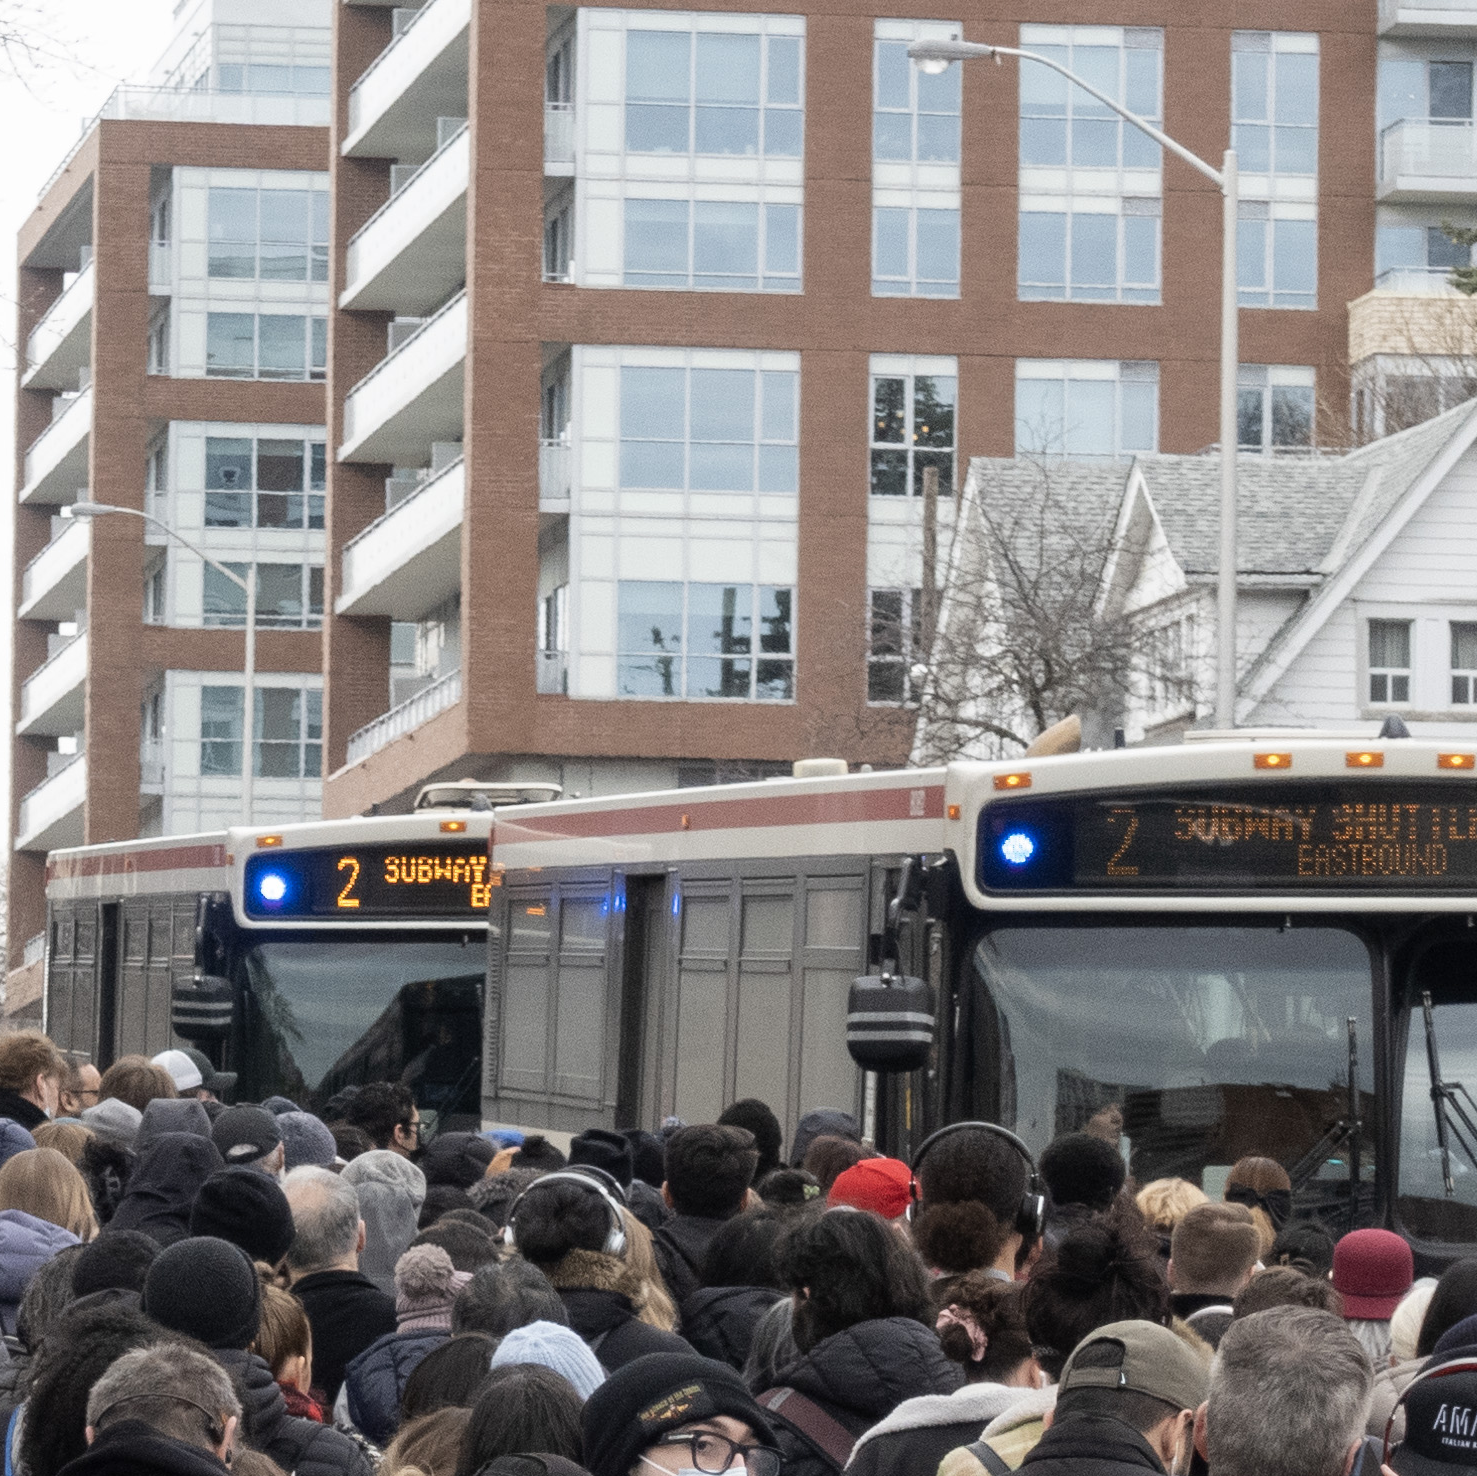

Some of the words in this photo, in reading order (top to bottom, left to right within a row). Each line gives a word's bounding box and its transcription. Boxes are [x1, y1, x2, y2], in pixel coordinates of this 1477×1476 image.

[1107, 808, 1139, 875] 2
[1174, 805, 1316, 840] SUBWAY
[1298, 843, 1448, 876] EASTBOUND
[337, 856, 360, 908] 2
[384, 855, 488, 883] SUBWAY
[1441, 1437, 1471, 1449] ITALIAN
